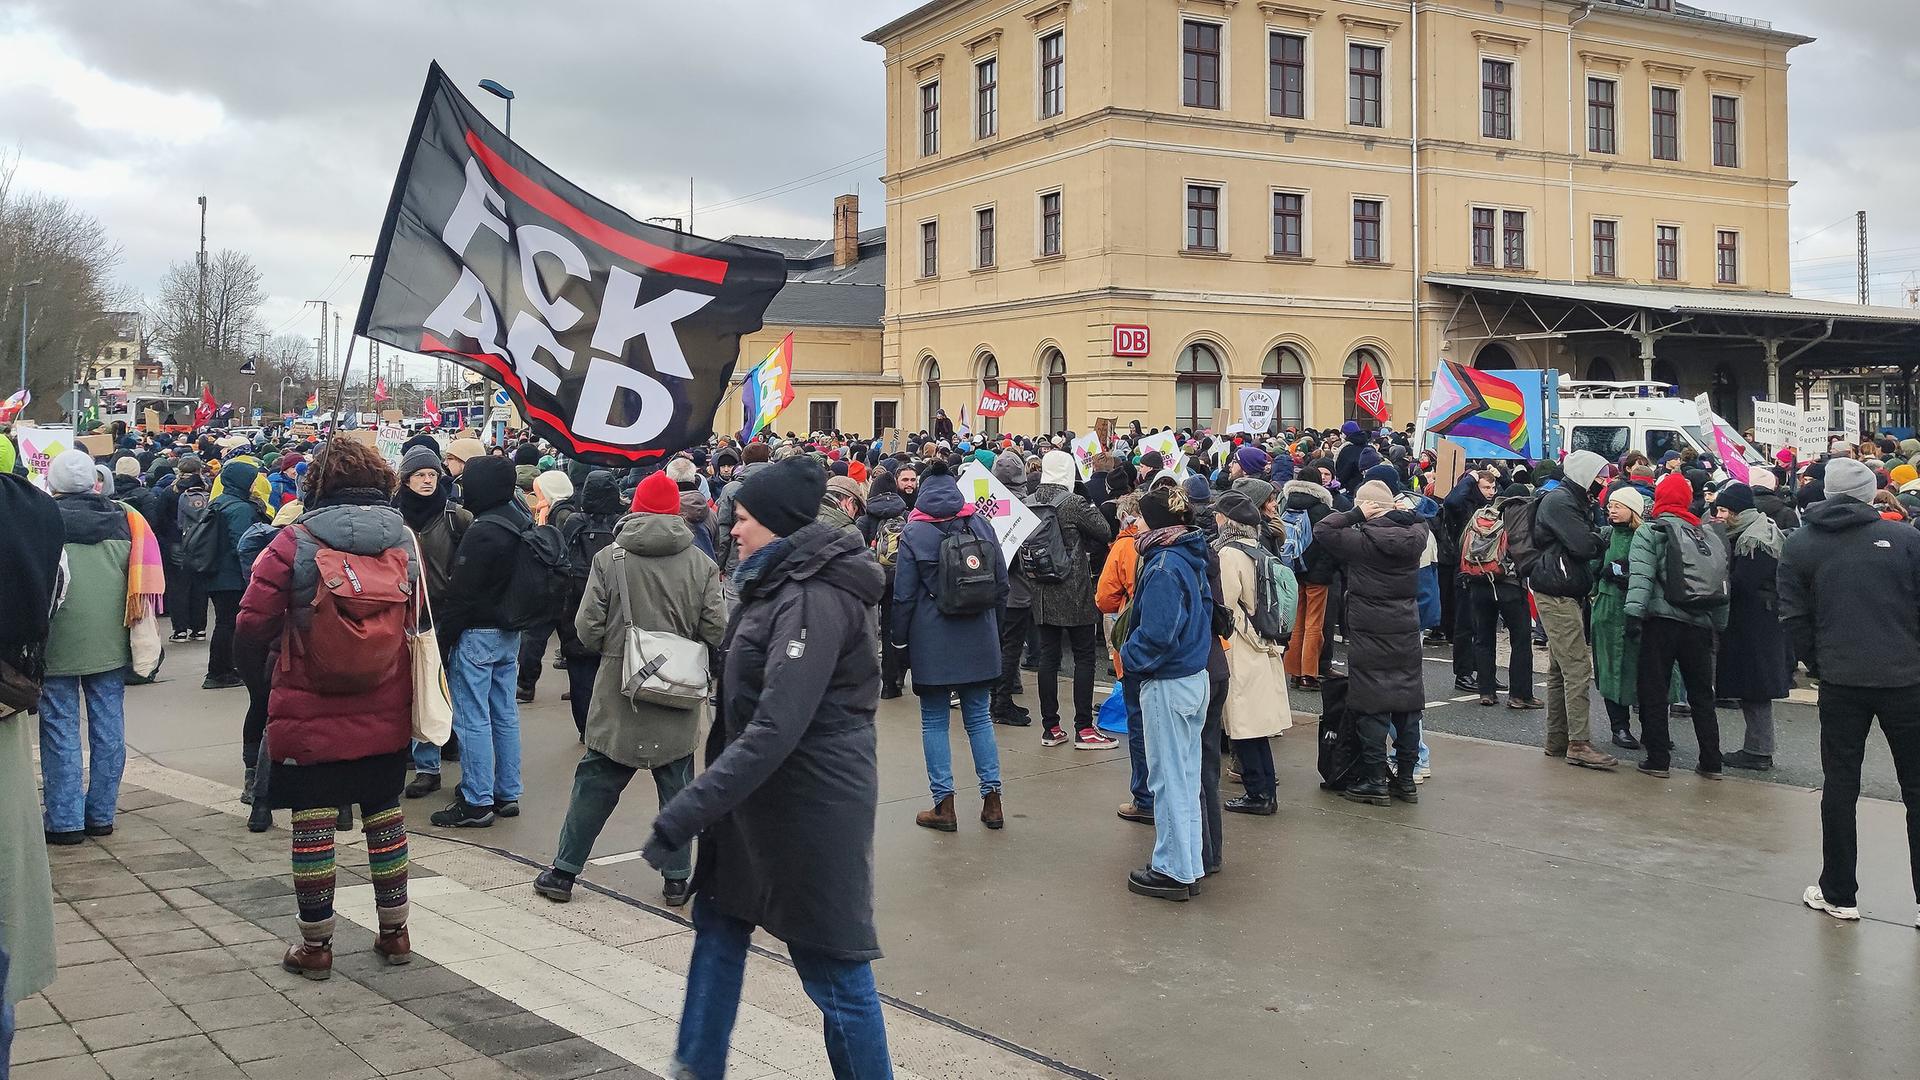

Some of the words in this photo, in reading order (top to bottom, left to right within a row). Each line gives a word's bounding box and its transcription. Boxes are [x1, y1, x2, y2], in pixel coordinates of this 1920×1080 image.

[442, 156, 717, 380] FCK
[1119, 330, 1146, 351] DB
[379, 427, 406, 441] KEINE
[32, 452, 50, 460] AFD
